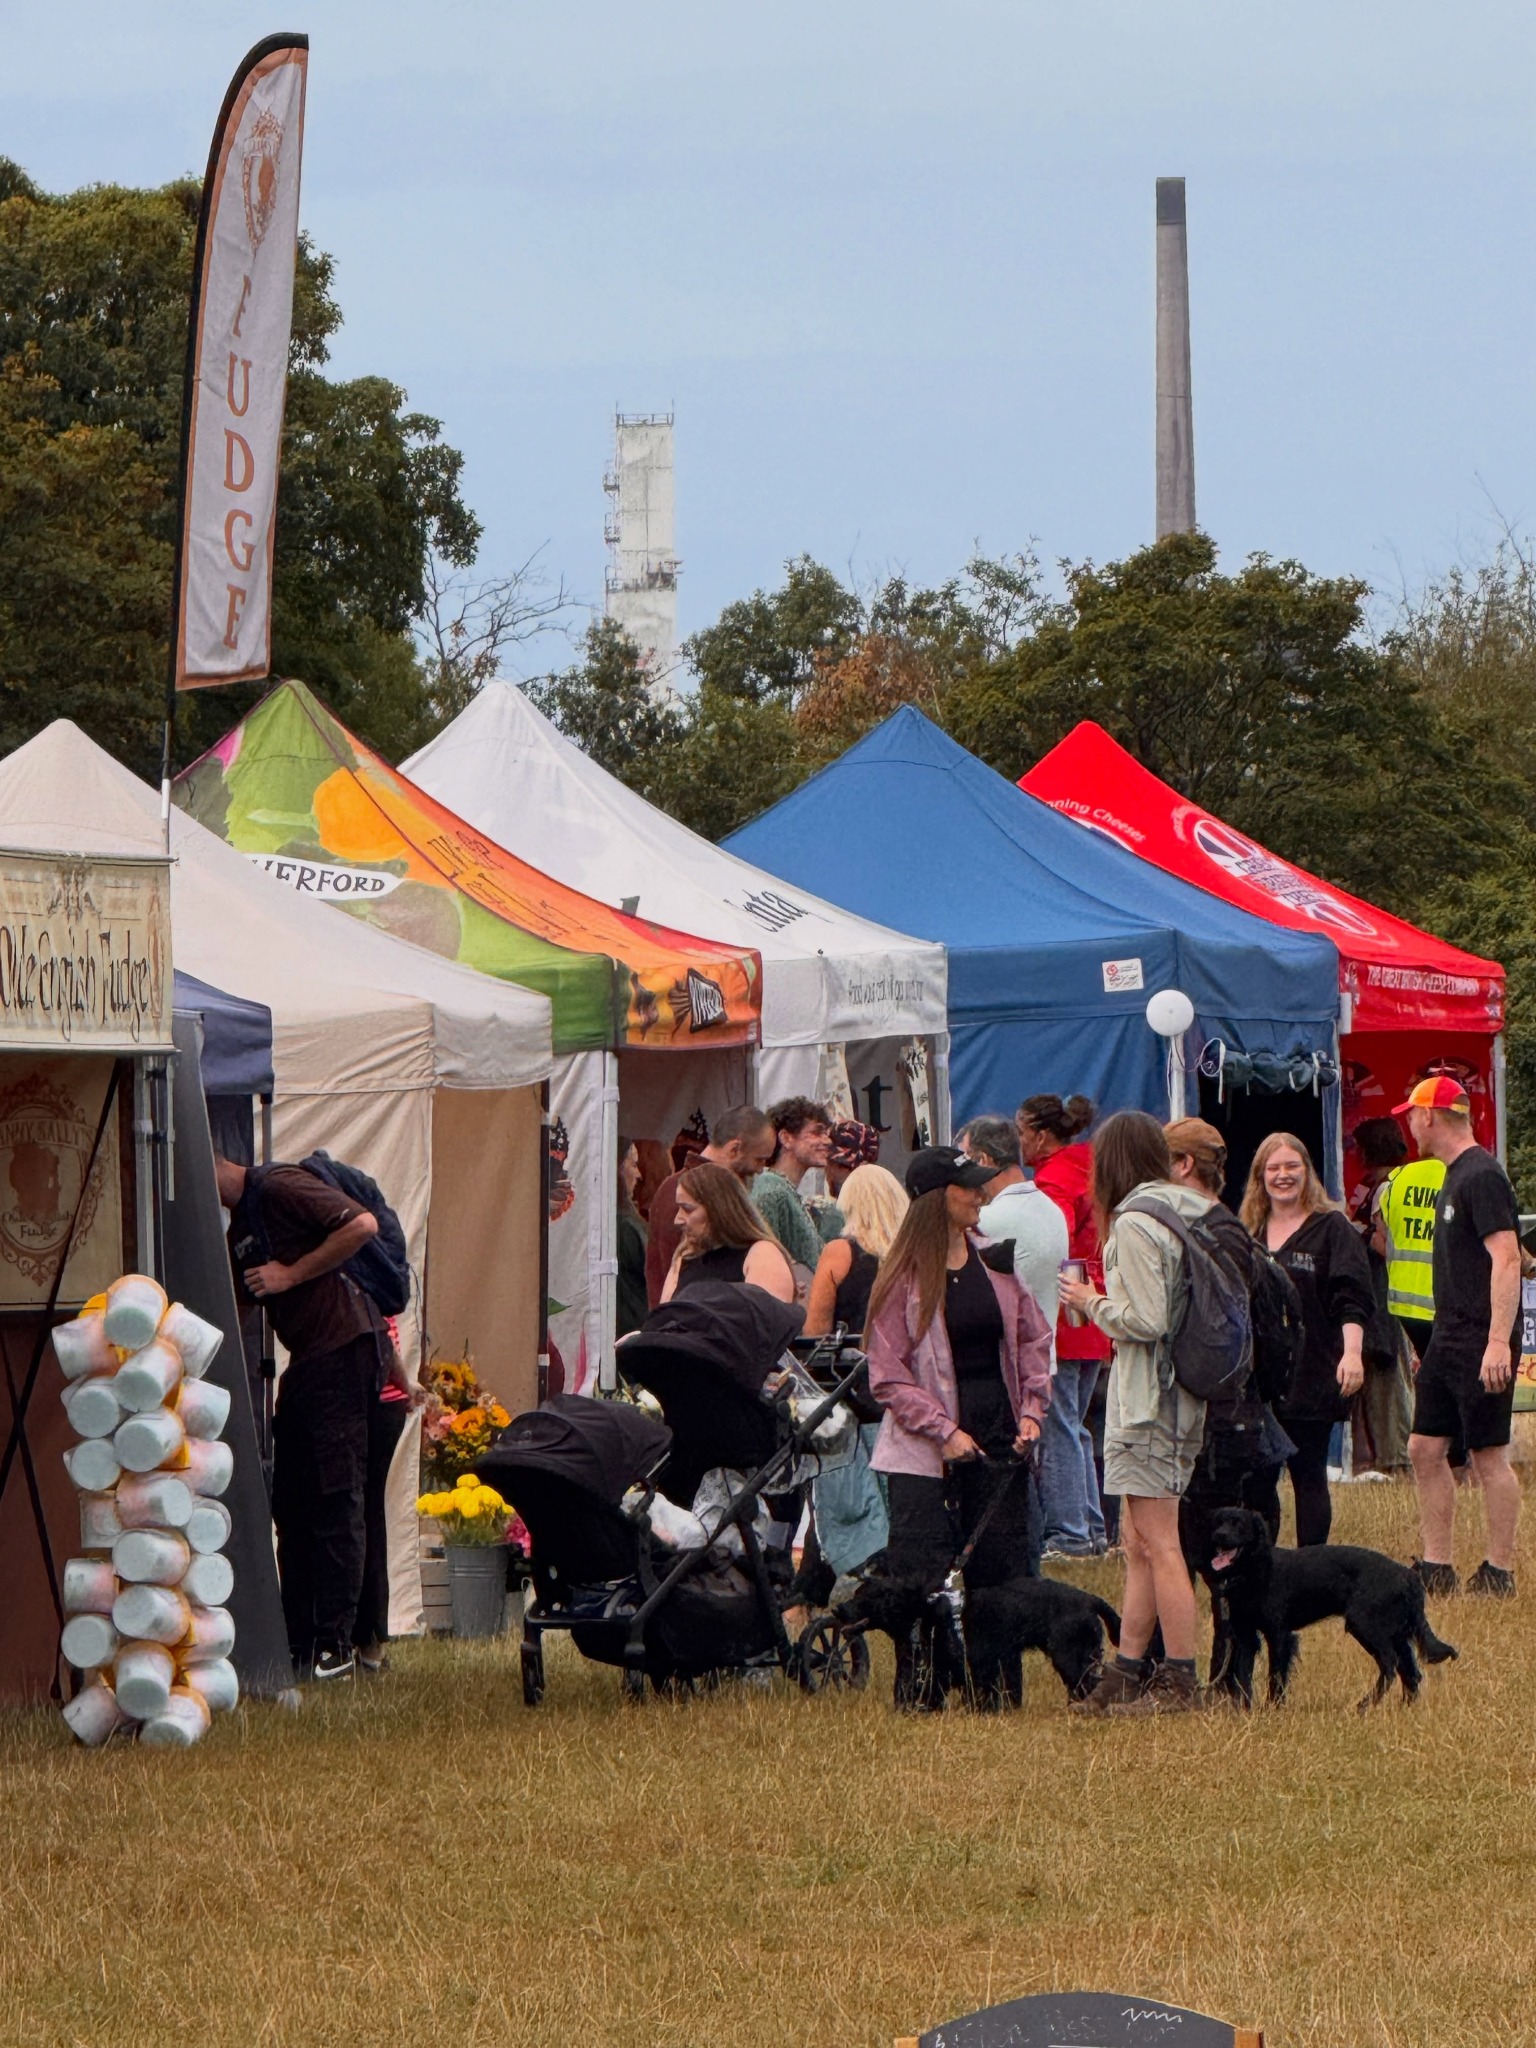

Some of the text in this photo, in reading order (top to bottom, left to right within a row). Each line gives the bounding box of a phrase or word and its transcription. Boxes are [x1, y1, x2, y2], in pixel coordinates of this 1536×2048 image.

[223, 274, 257, 649] FUDGE
[1093, 808, 1147, 842] Cheeses
[252, 859, 385, 892] ERFORD
[99, 924, 149, 1042] Fudge
[1402, 1217, 1434, 1240] TEA
